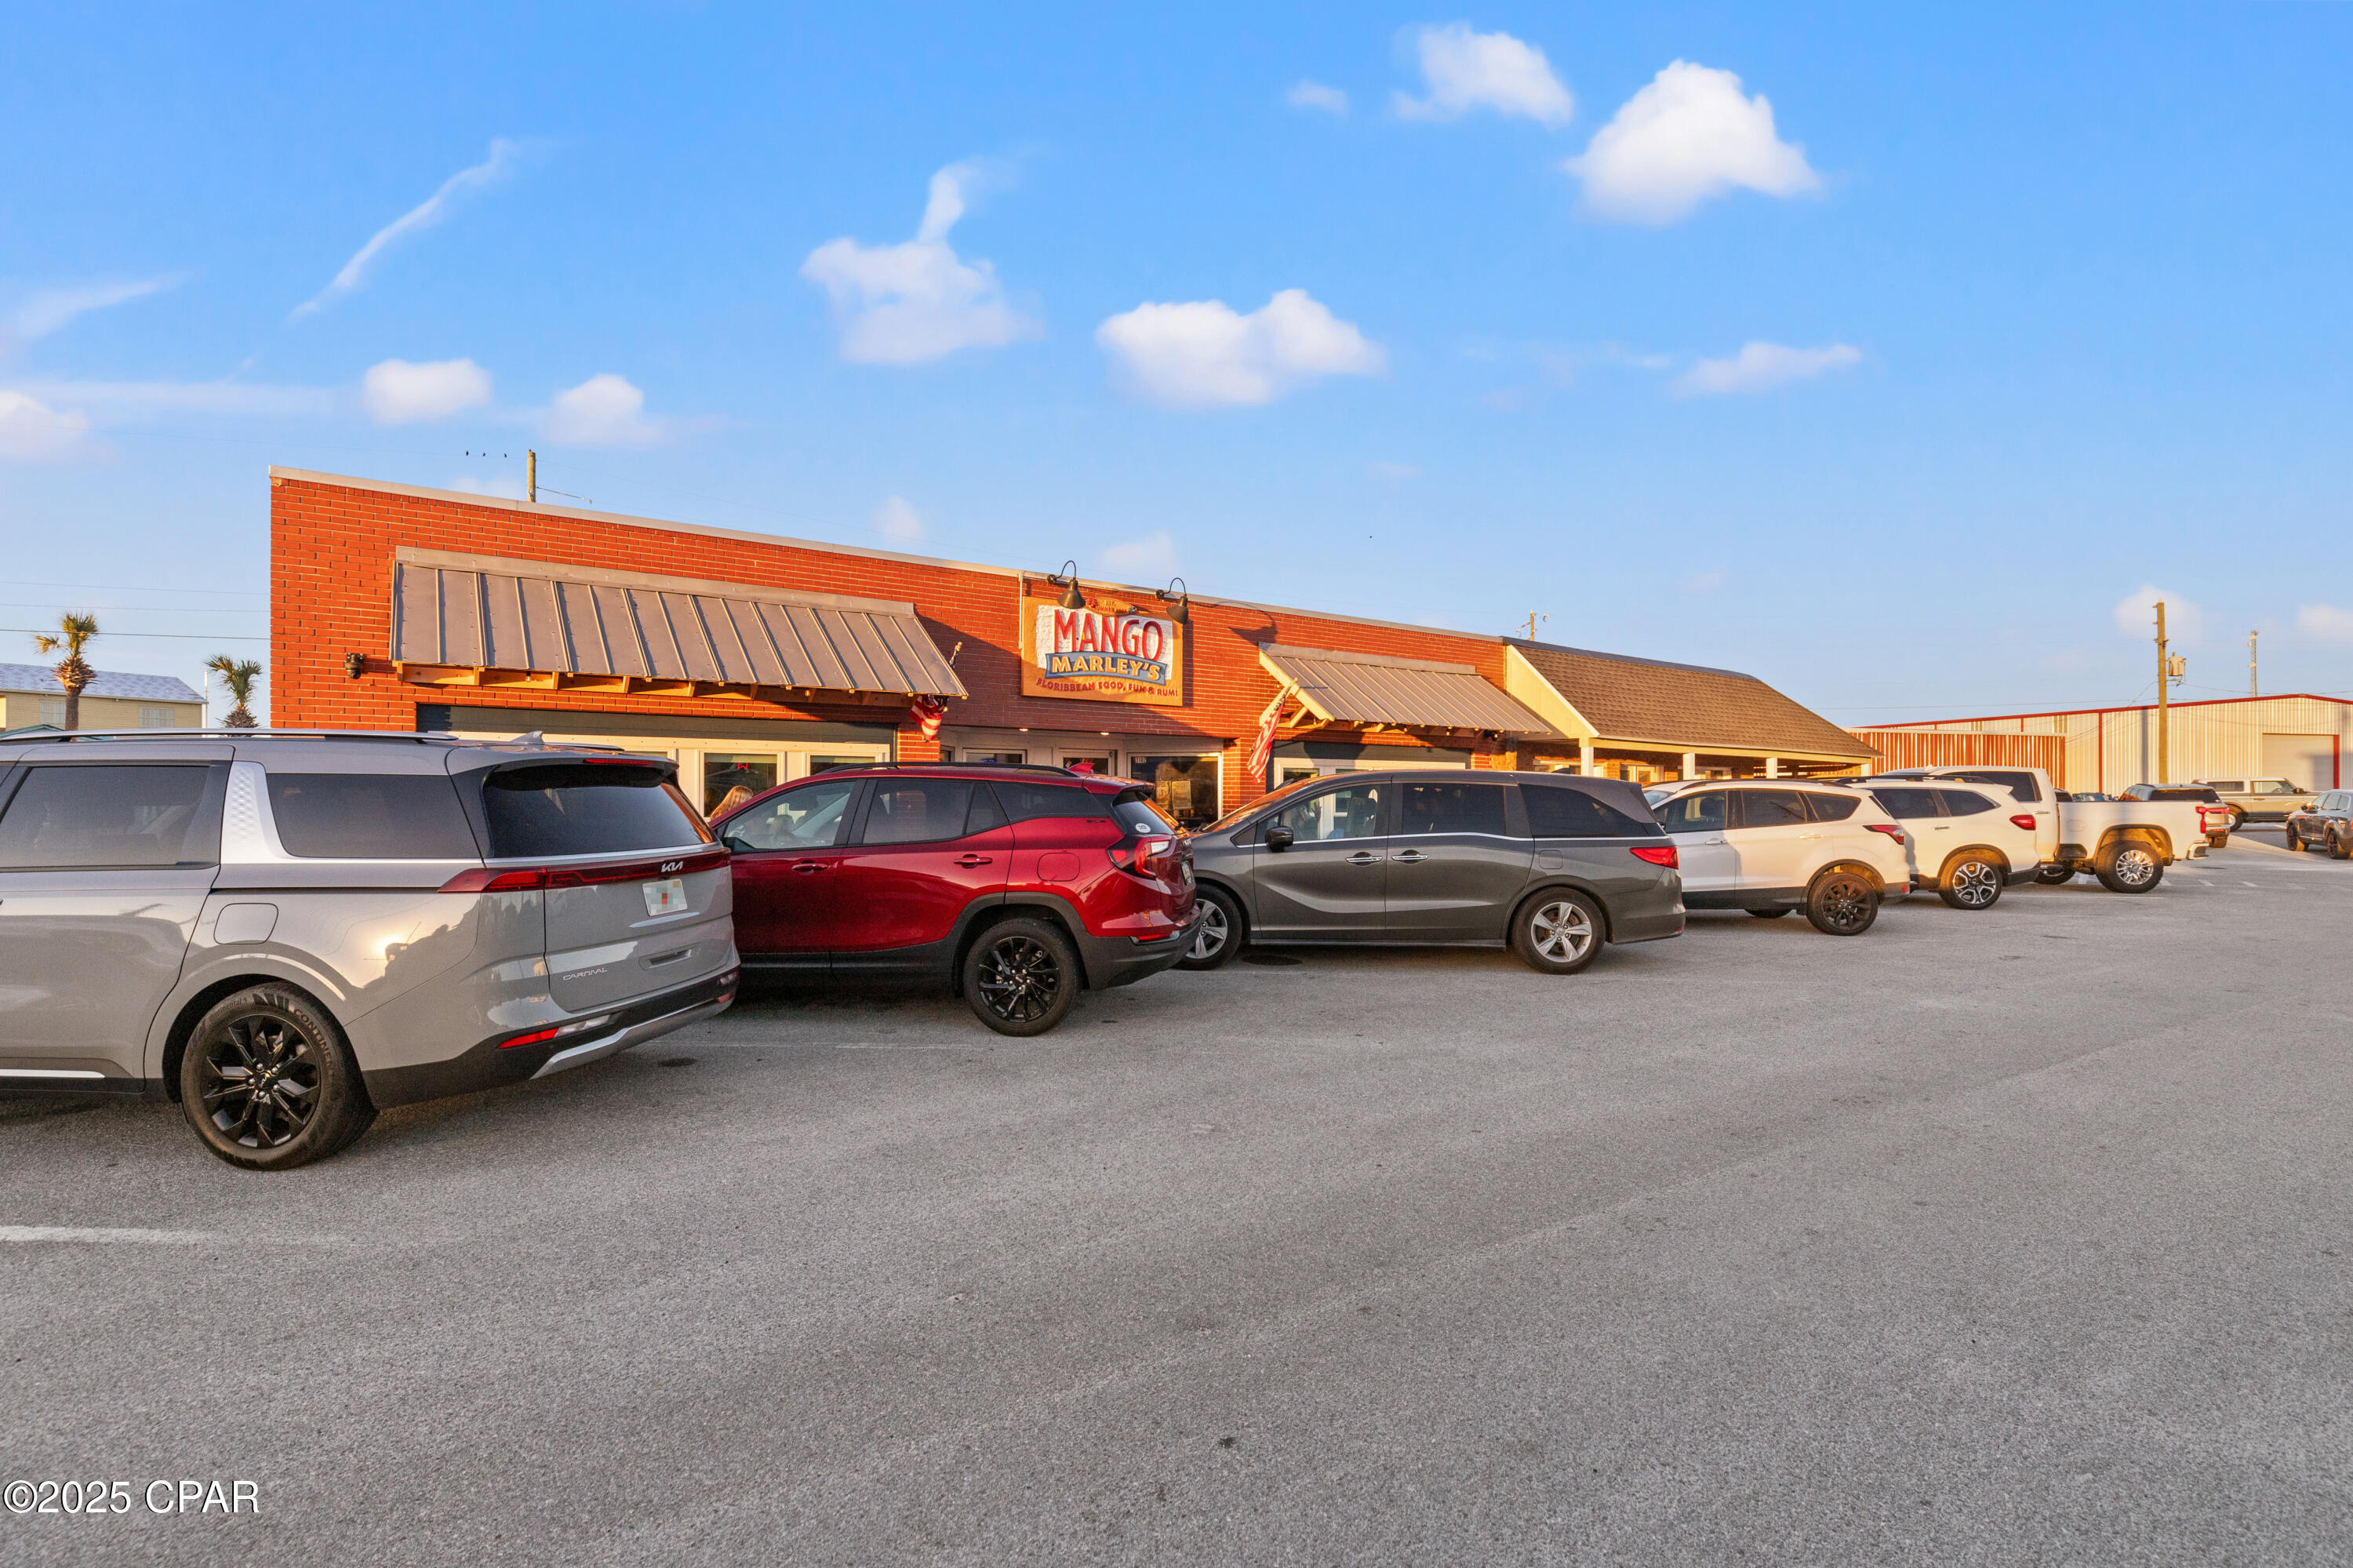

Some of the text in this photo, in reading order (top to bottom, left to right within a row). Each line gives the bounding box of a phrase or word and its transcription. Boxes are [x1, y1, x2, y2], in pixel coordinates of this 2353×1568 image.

[1053, 609, 1163, 661] MANGO
[1051, 656, 1161, 681] MARLEY'S
[1035, 677, 1178, 697] FLORIBBEAN FOOD, FUN & RUM!
[661, 860, 684, 873] KIA
[562, 967, 609, 980] CARNIVAL
